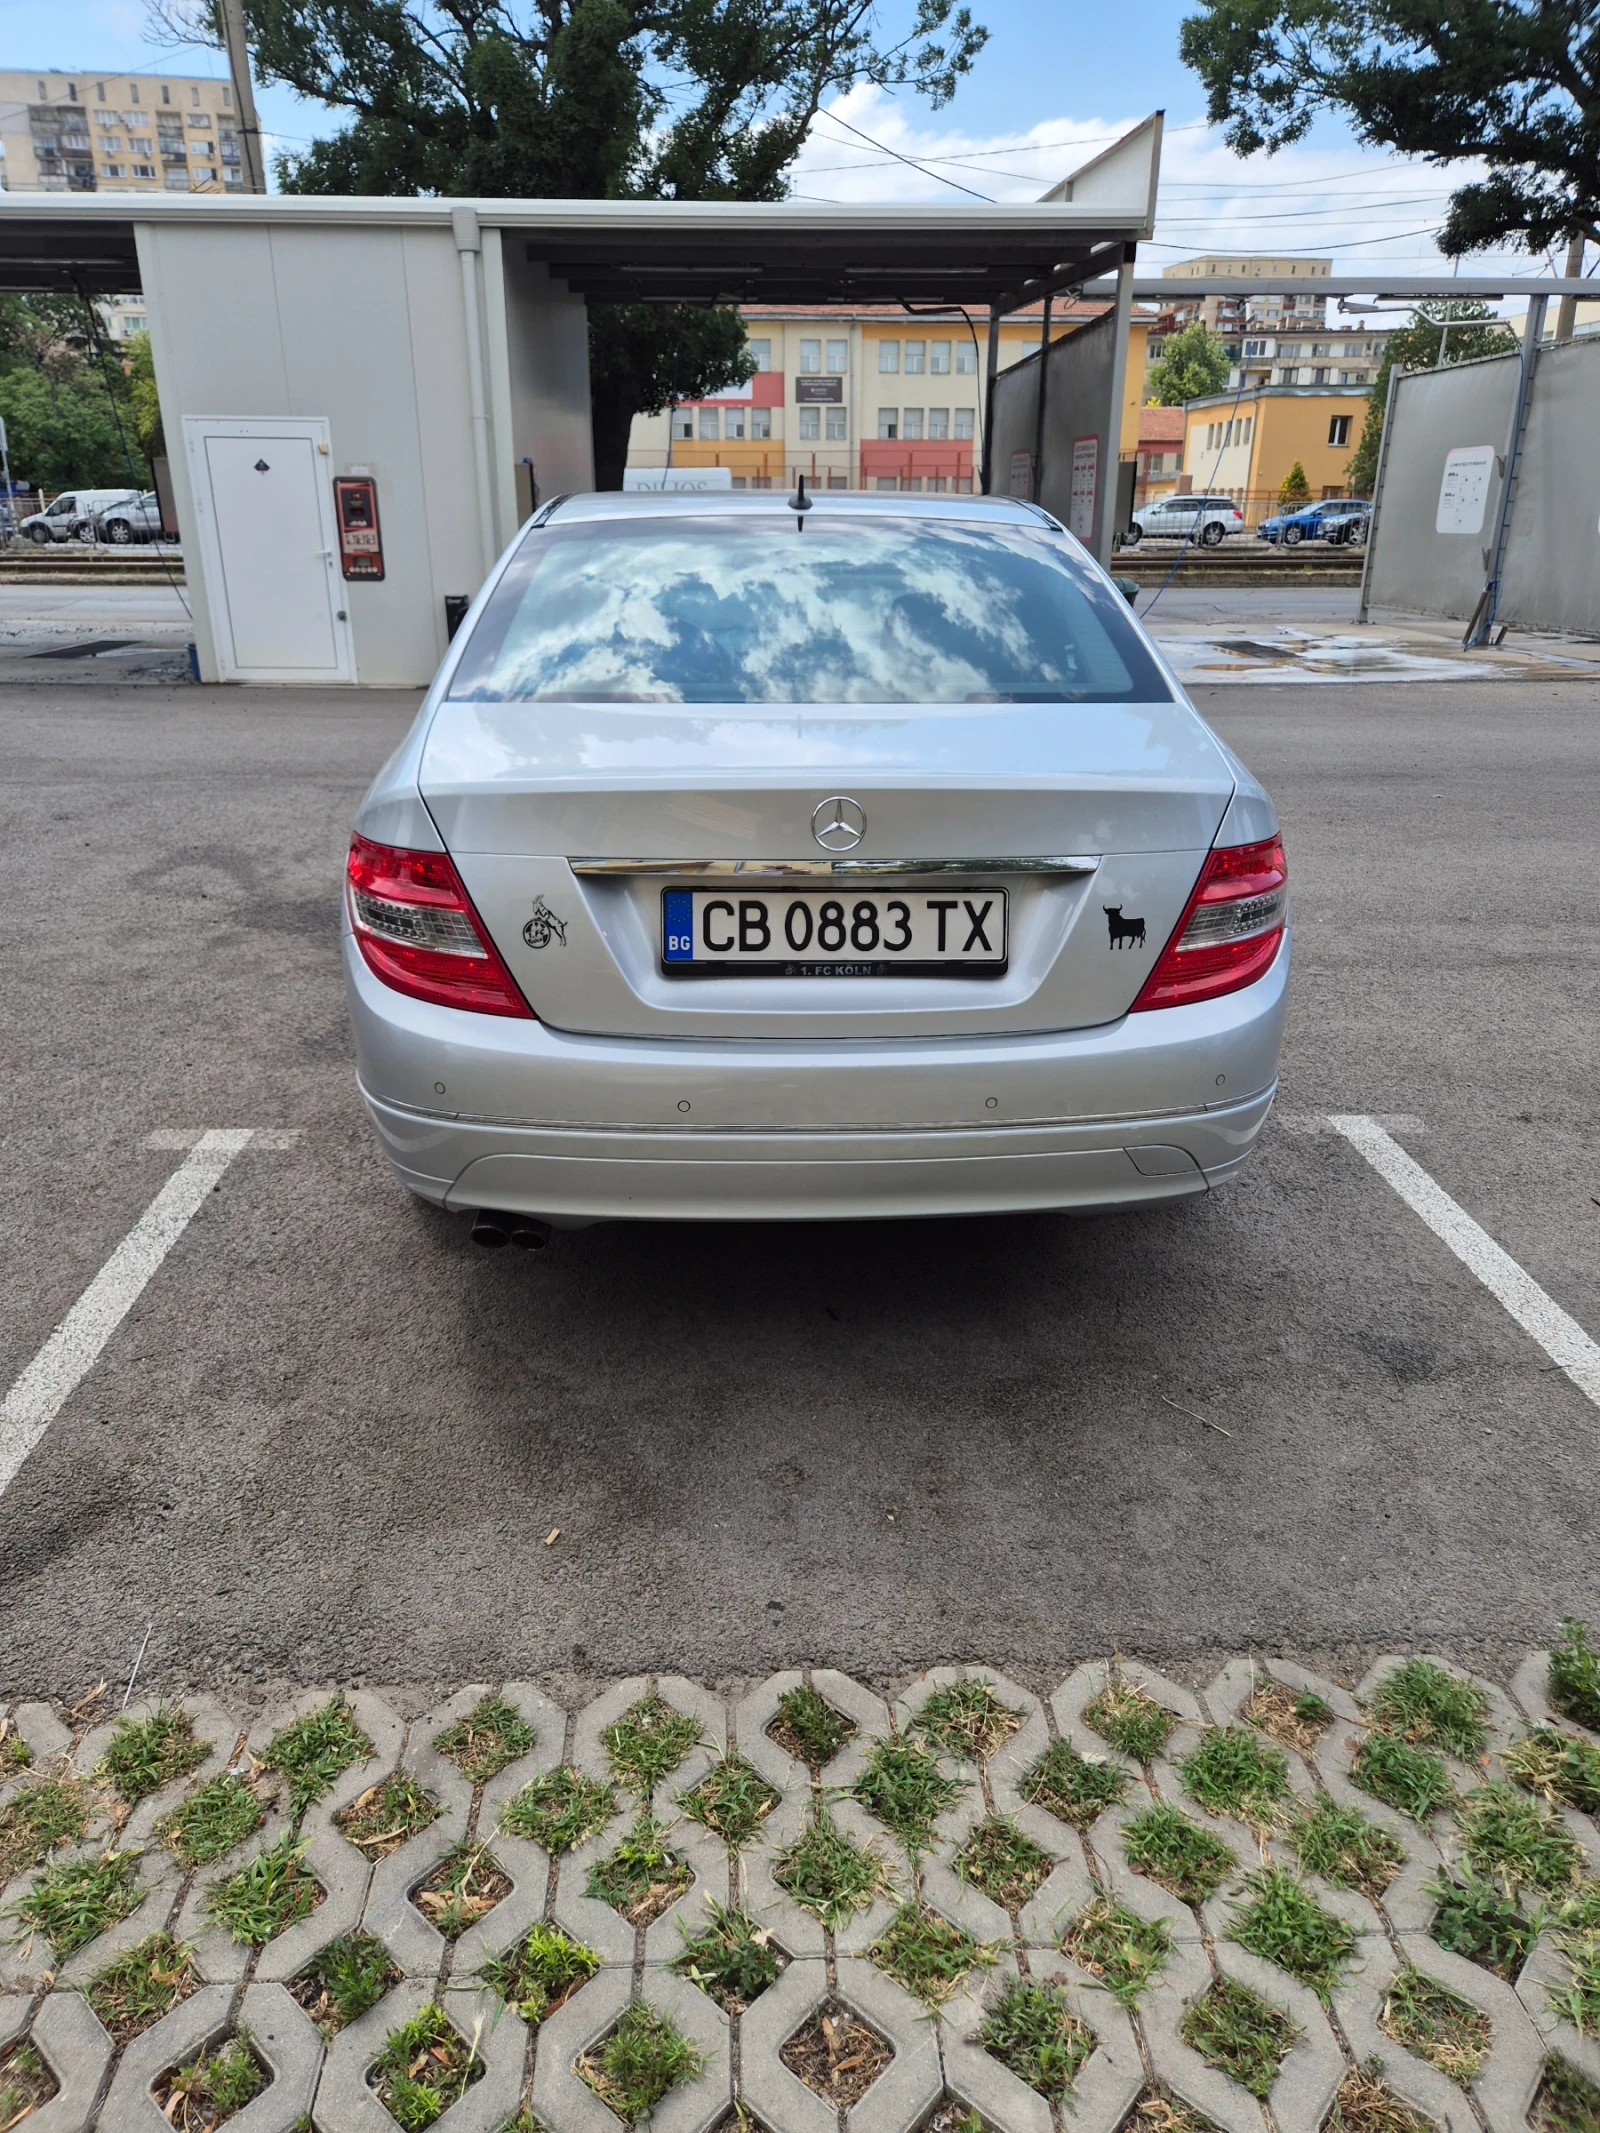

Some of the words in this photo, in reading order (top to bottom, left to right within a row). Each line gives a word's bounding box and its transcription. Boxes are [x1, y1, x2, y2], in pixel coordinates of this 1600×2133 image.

[702, 900, 771, 952] CB
[784, 900, 913, 952] 0883
[926, 900, 994, 952] TX
[668, 935, 691, 951] BG
[800, 966, 812, 976] 1.
[815, 966, 832, 976] FC
[835, 964, 872, 976] KÖLN
